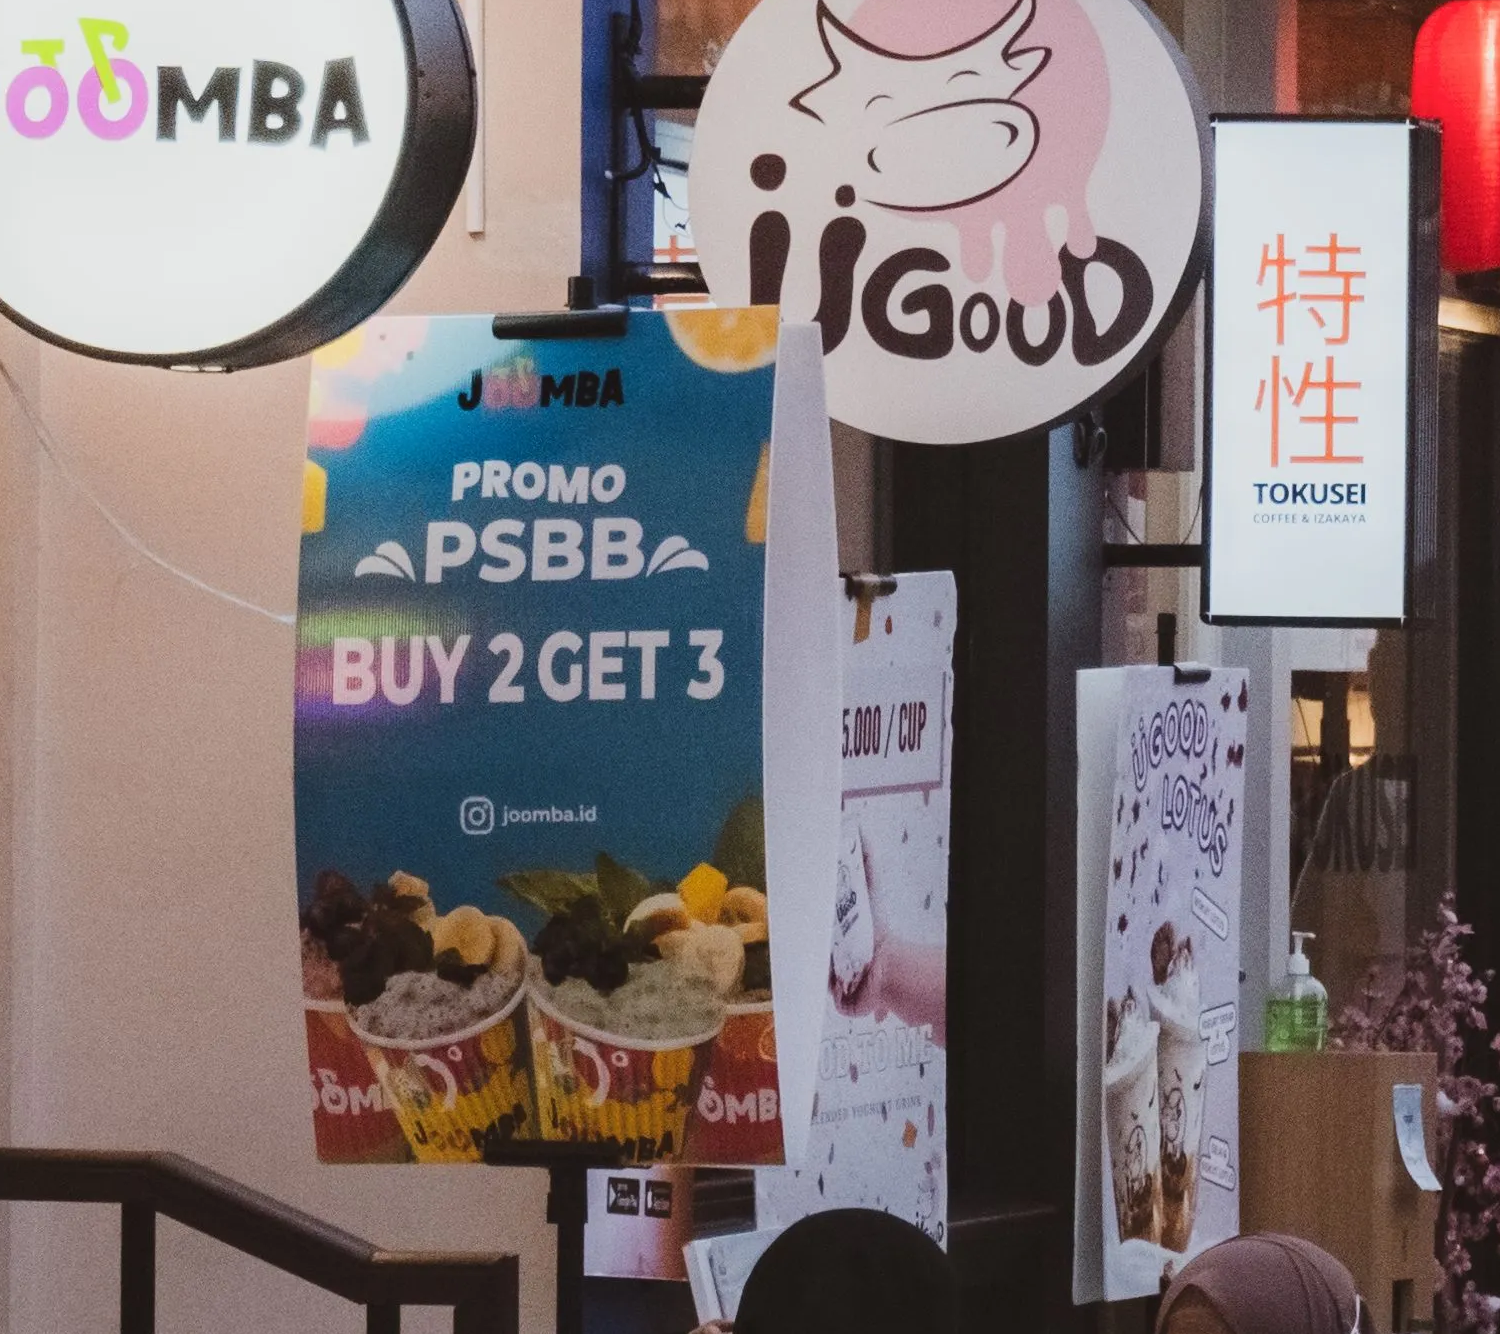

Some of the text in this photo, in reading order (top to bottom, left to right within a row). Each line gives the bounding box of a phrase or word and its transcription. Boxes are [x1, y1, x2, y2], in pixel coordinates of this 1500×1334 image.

[1255, 232, 1367, 468] 特性
[457, 359, 625, 411] JOOMBA
[451, 459, 627, 505] PROMO
[1253, 482, 1367, 505] TOKUSEI
[1253, 513, 1367, 524] COFFEE & IZAKAYA
[425, 516, 647, 585] PSBB
[332, 628, 726, 707] BUY 2 GET 3
[898, 700, 927, 752] CUP
[501, 803, 598, 827] joomba.id
[1161, 772, 1227, 877] LOTUS
